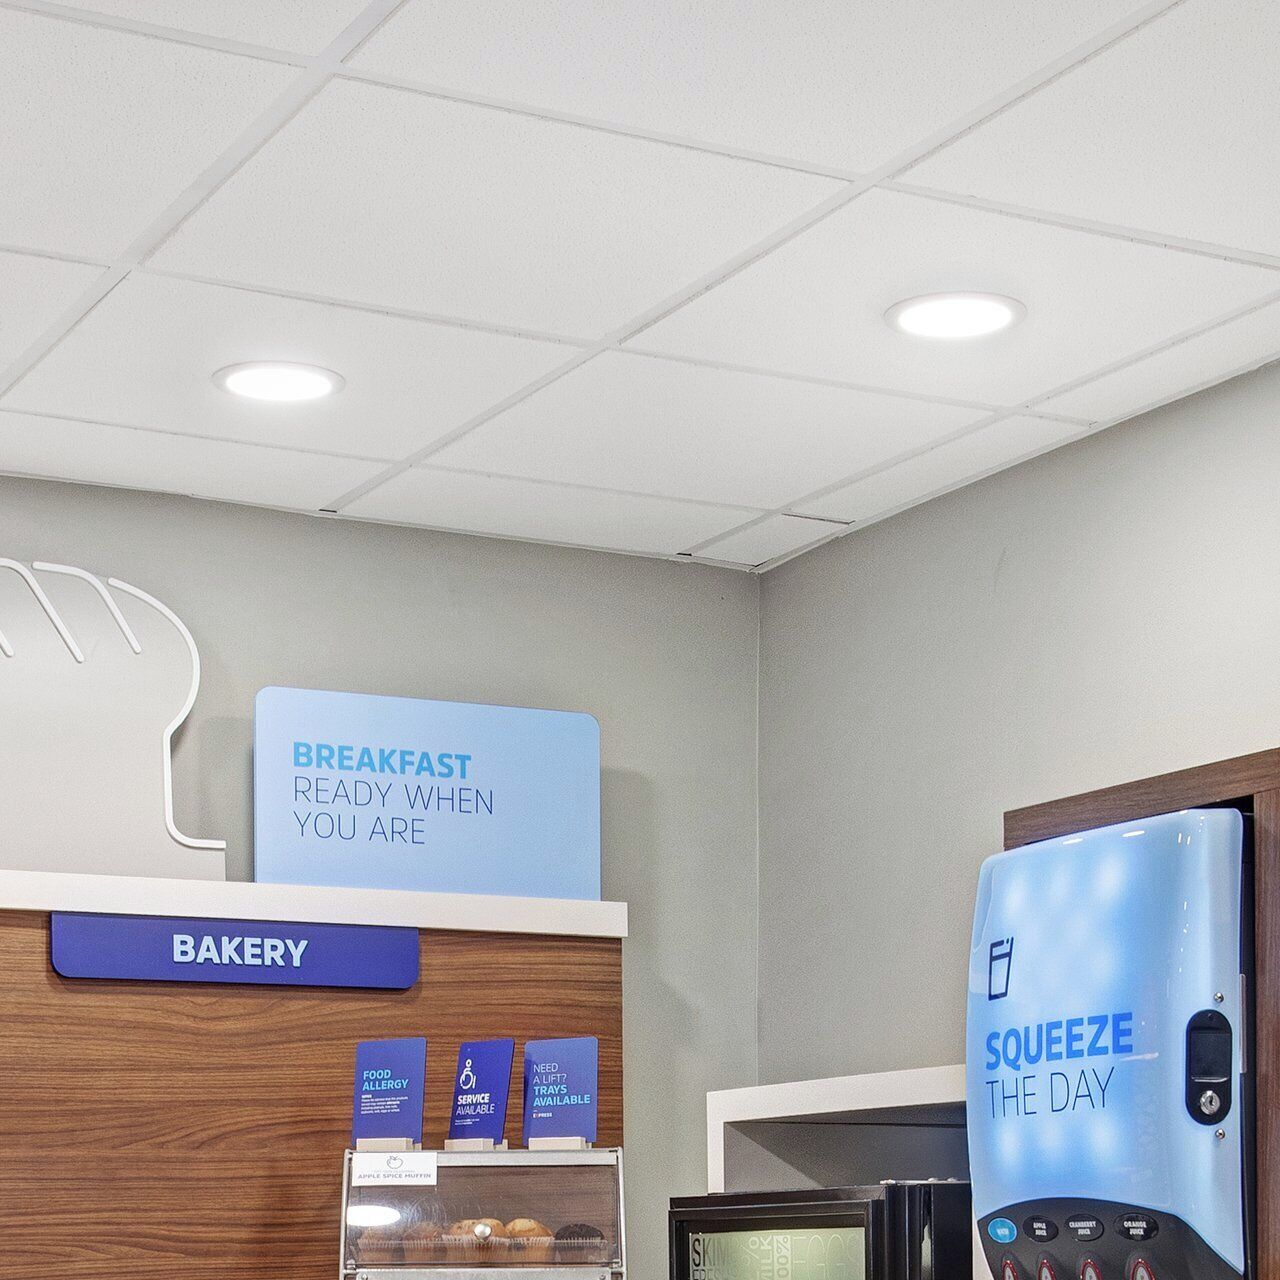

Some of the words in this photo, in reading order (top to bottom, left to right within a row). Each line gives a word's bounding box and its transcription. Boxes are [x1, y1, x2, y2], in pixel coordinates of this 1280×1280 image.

[293, 741, 472, 780] BREAKFAST
[294, 776, 393, 807] READY
[404, 783, 494, 815] WHEN
[293, 810, 356, 841] YOU
[368, 816, 426, 845] ARE
[173, 934, 309, 968] BAKERY
[985, 1011, 1134, 1071] SQUEEZE
[533, 1063, 559, 1073] NEED
[363, 1069, 391, 1080] FOOD
[533, 1076, 540, 1084] A
[543, 1074, 566, 1084] LIFT?
[362, 1079, 409, 1091] ALLERGY
[533, 1085, 567, 1095] TRAYS
[986, 1075, 1037, 1118] THE
[1050, 1066, 1115, 1113] DAY
[457, 1093, 490, 1105] SERVICE
[533, 1094, 590, 1107] AVAILABLE
[456, 1104, 495, 1116] AVAILABLE
